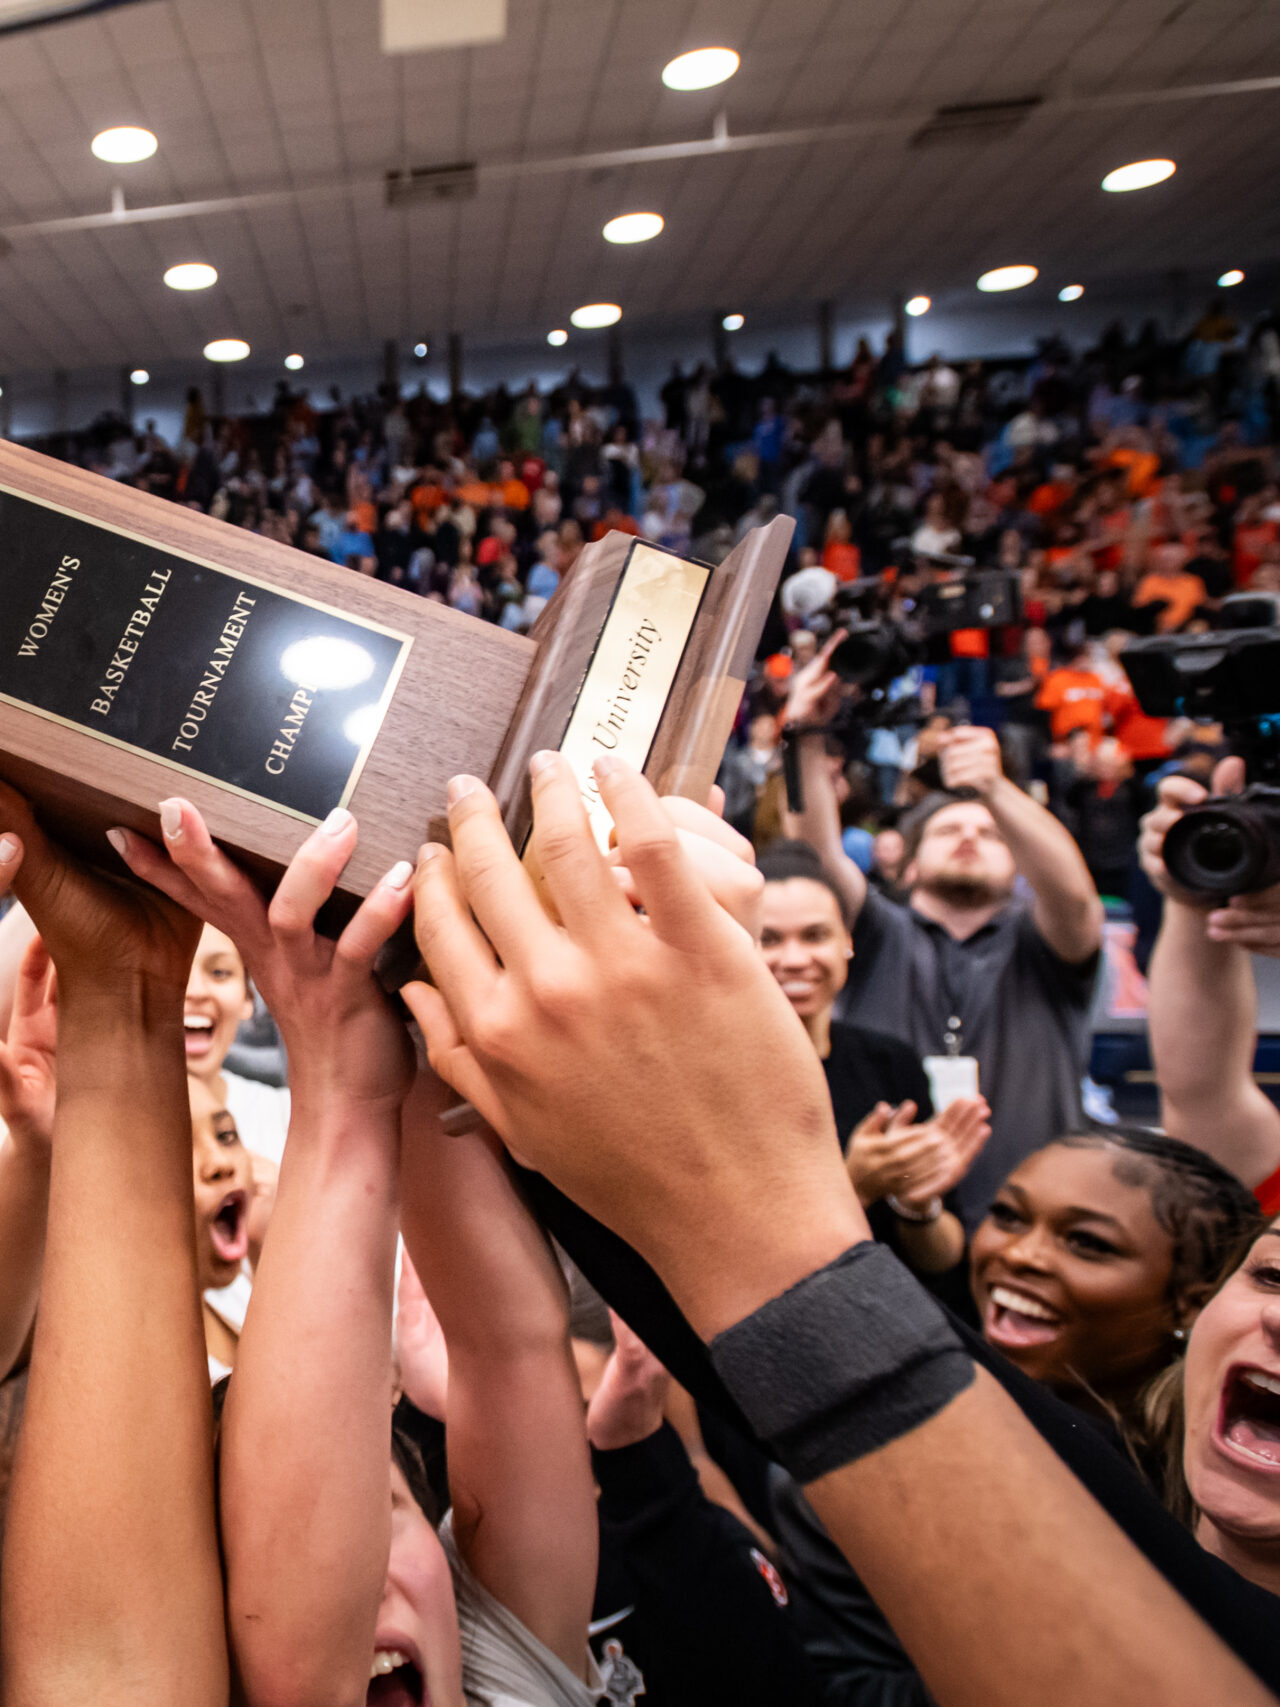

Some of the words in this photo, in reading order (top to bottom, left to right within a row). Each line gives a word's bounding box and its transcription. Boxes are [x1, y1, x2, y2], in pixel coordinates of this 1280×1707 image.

[17, 554, 82, 660] WOMEN'S
[90, 566, 173, 716] BASKETBALL
[171, 590, 258, 753] TOURNAMENT
[592, 618, 662, 750] University
